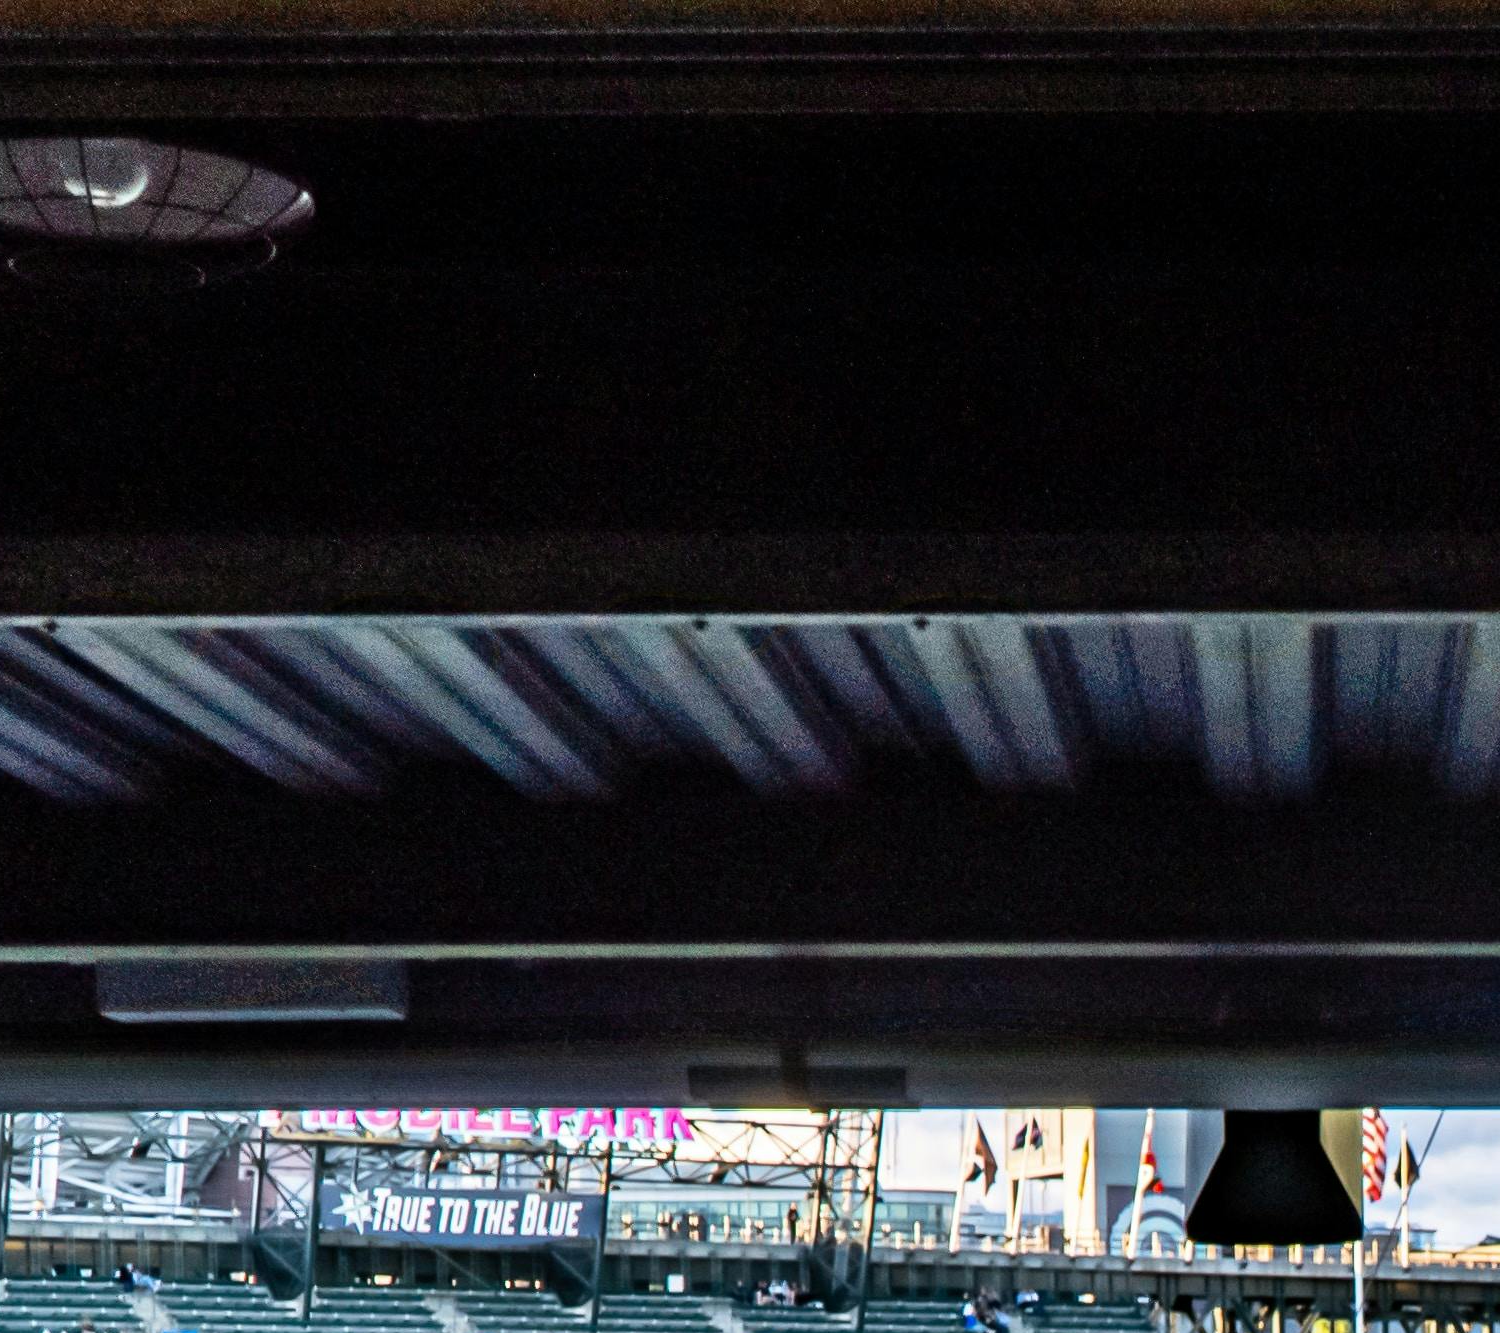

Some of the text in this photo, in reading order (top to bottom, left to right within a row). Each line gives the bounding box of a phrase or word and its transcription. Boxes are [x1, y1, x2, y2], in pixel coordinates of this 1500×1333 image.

[373, 1187, 583, 1237] TRUE TO THE BLUE
